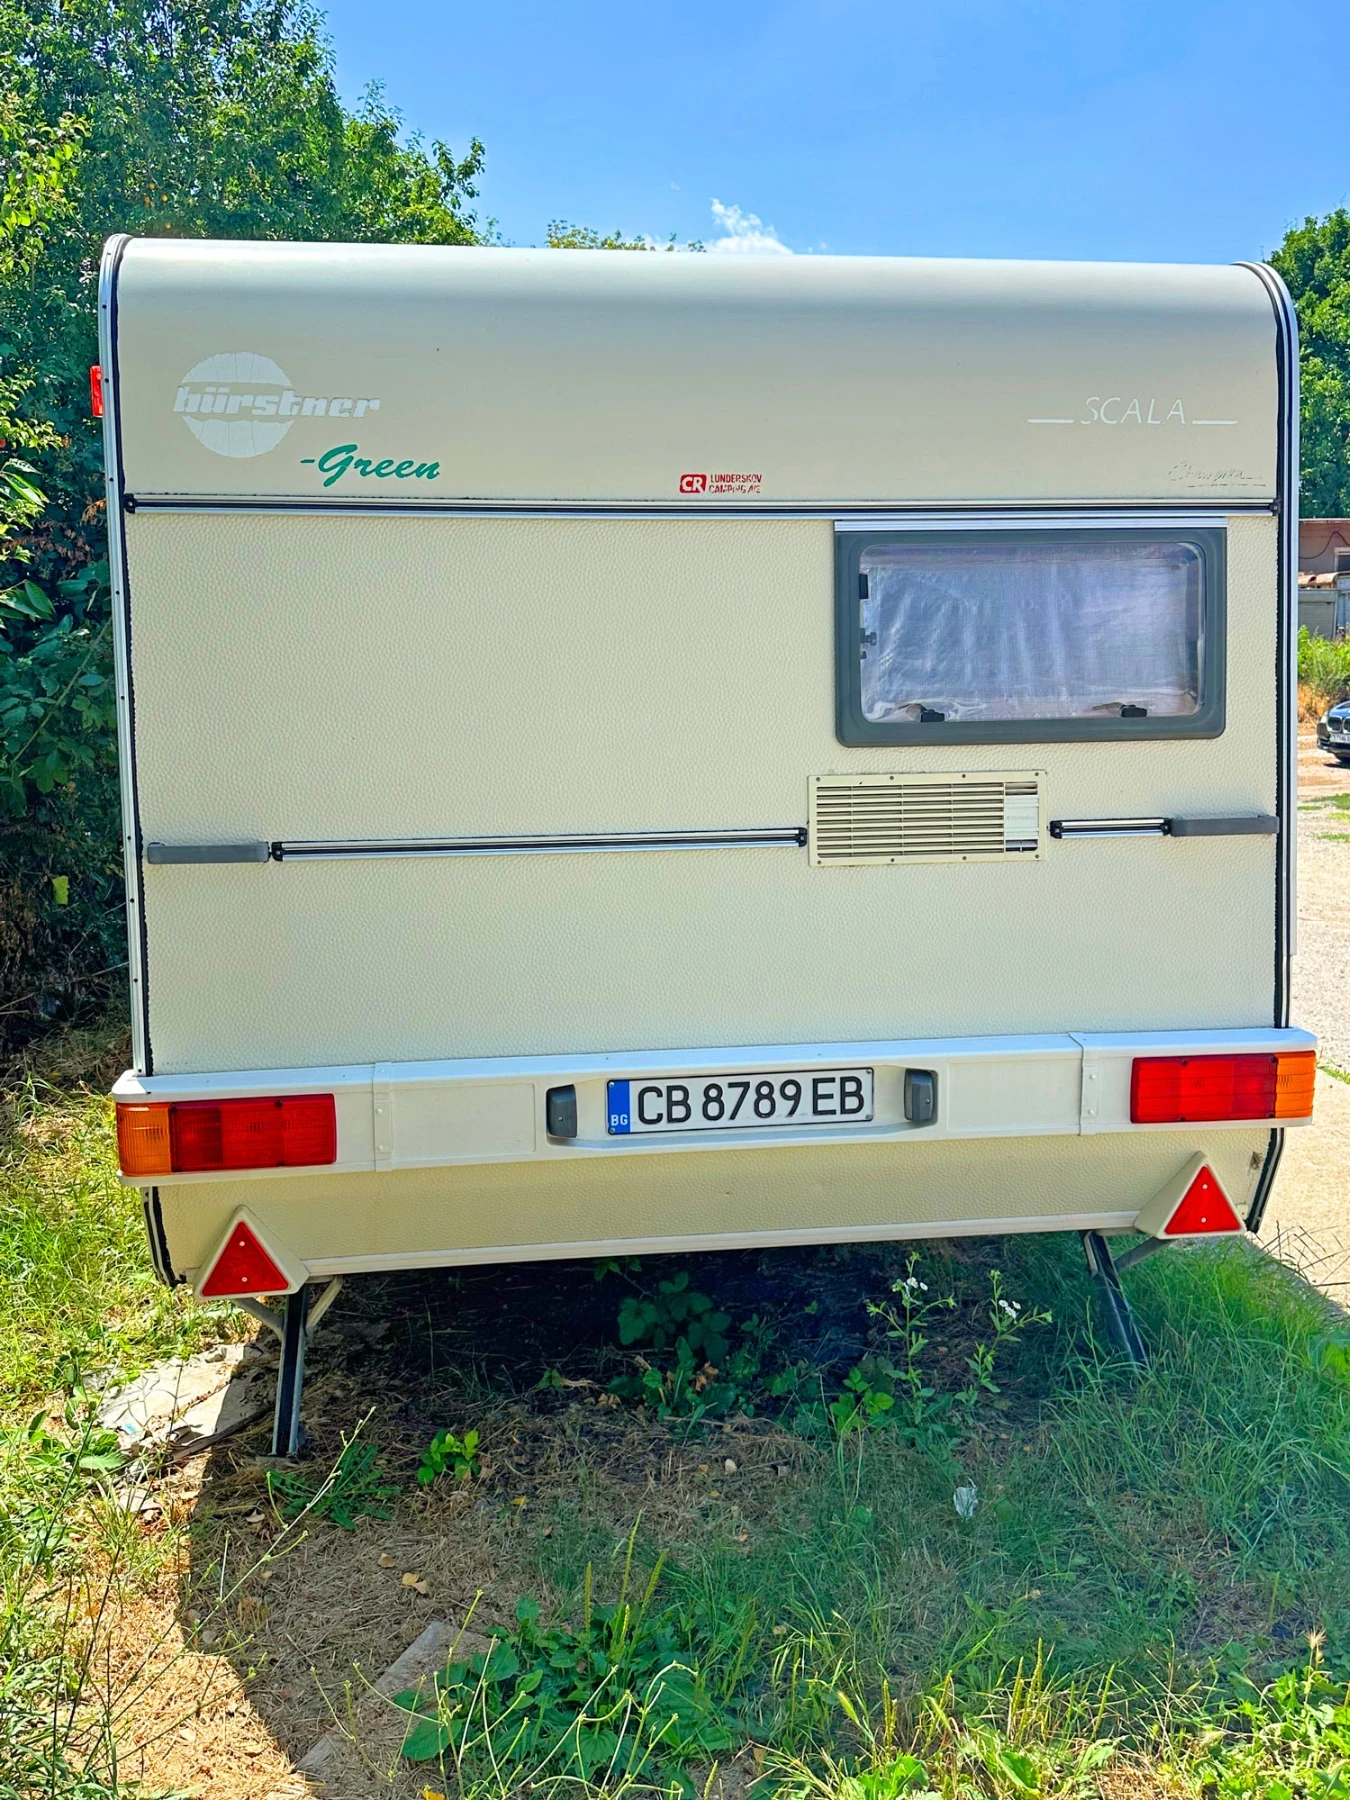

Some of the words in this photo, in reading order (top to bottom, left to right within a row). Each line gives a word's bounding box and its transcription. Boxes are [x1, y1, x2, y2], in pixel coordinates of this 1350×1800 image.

[173, 385, 381, 418] bürstner
[1080, 397, 1186, 425] SCALA
[681, 476, 704, 493] CR
[637, 1084, 692, 1125] CB
[702, 1079, 802, 1121] 8789
[812, 1076, 865, 1116] EB
[611, 1114, 628, 1126] BG
